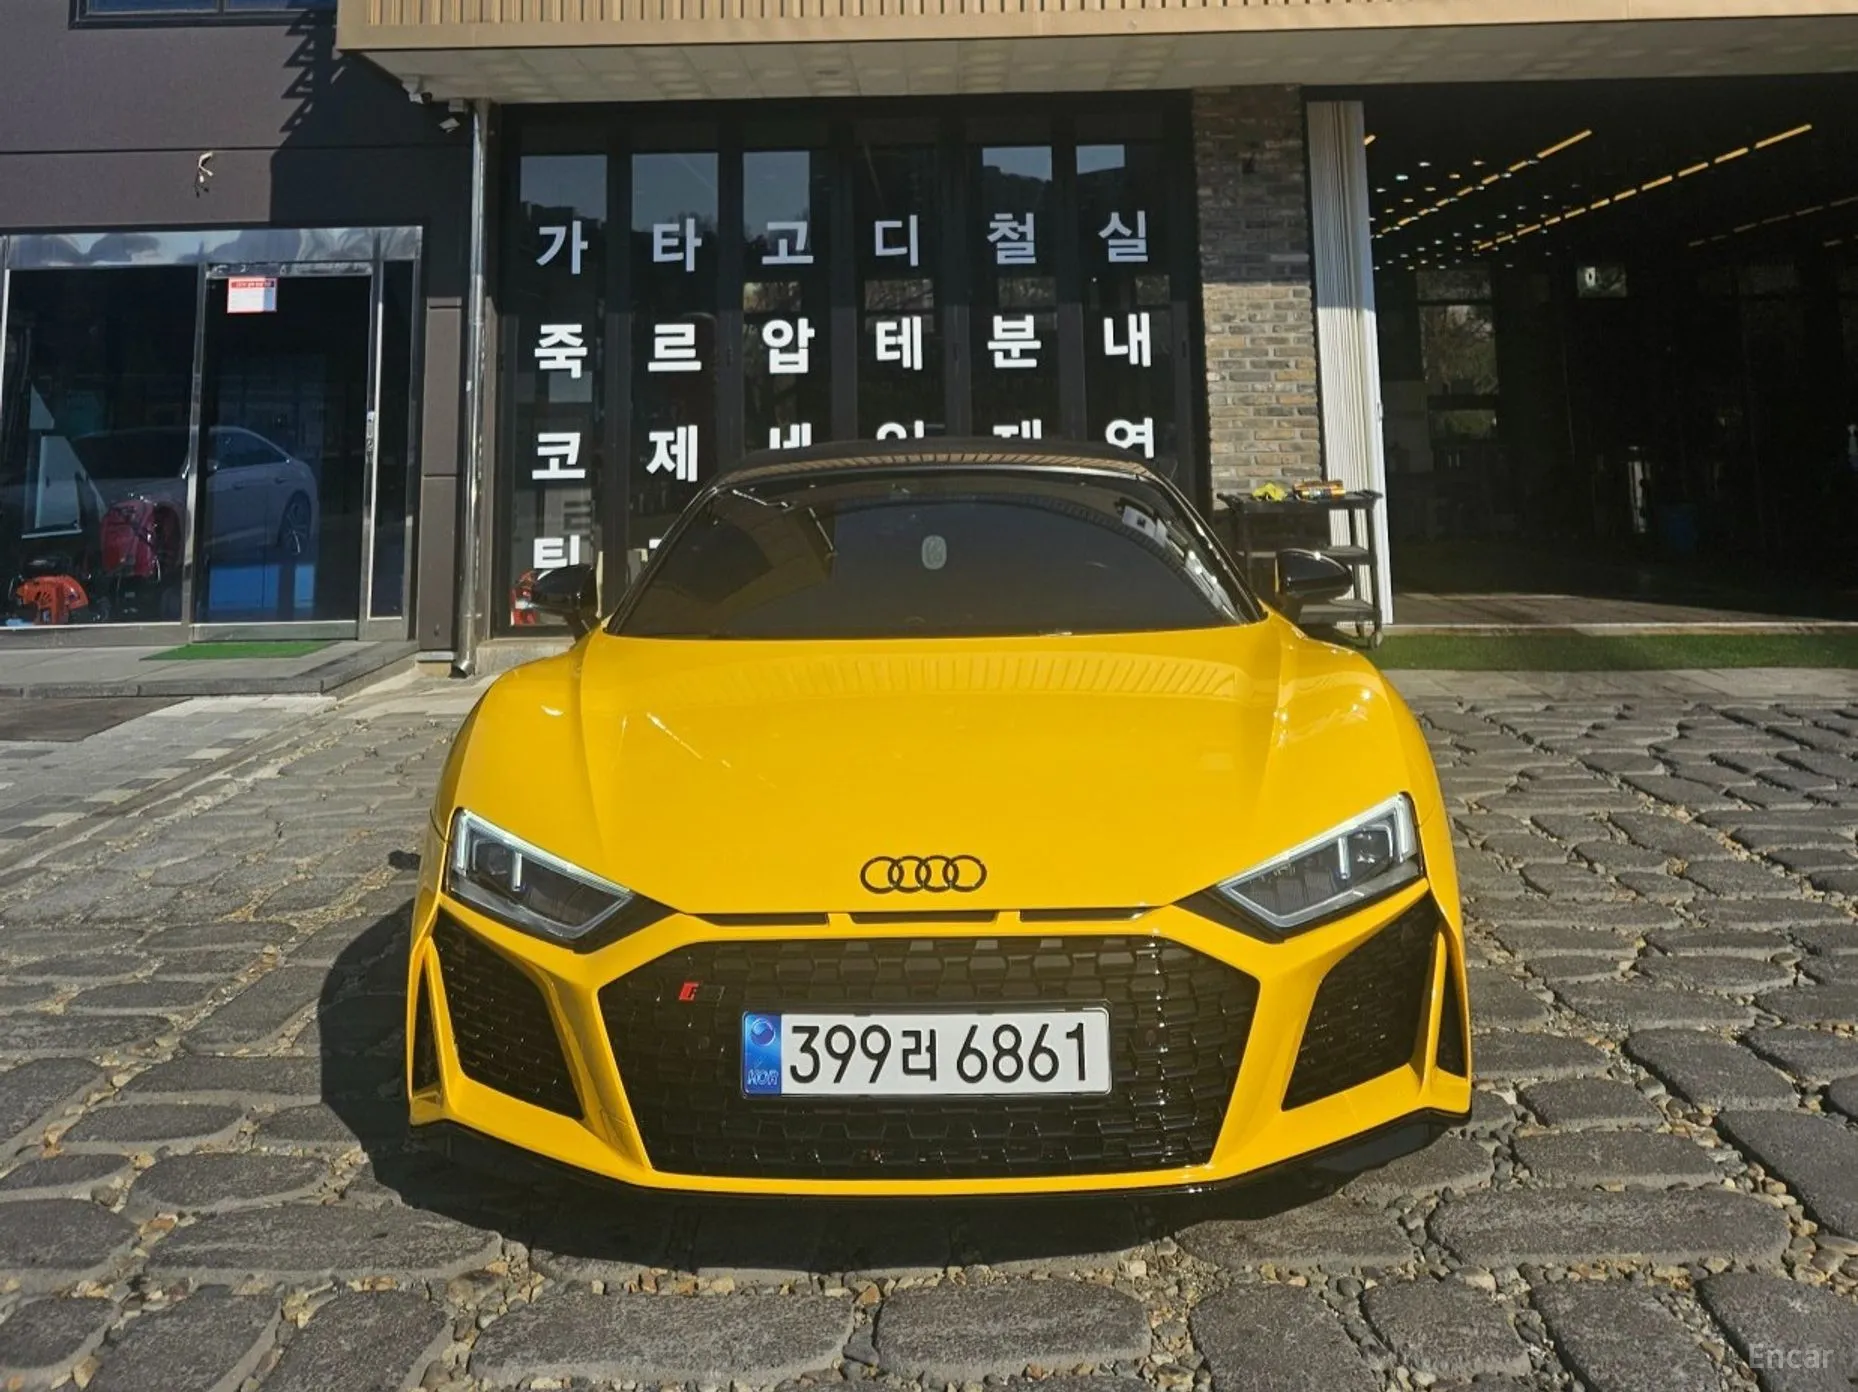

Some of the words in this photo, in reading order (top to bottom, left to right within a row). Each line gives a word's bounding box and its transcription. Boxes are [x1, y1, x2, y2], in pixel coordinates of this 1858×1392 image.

[647, 218, 702, 549] 타르제
[790, 1024, 937, 1084] 399러
[956, 1023, 1086, 1084] 6861
